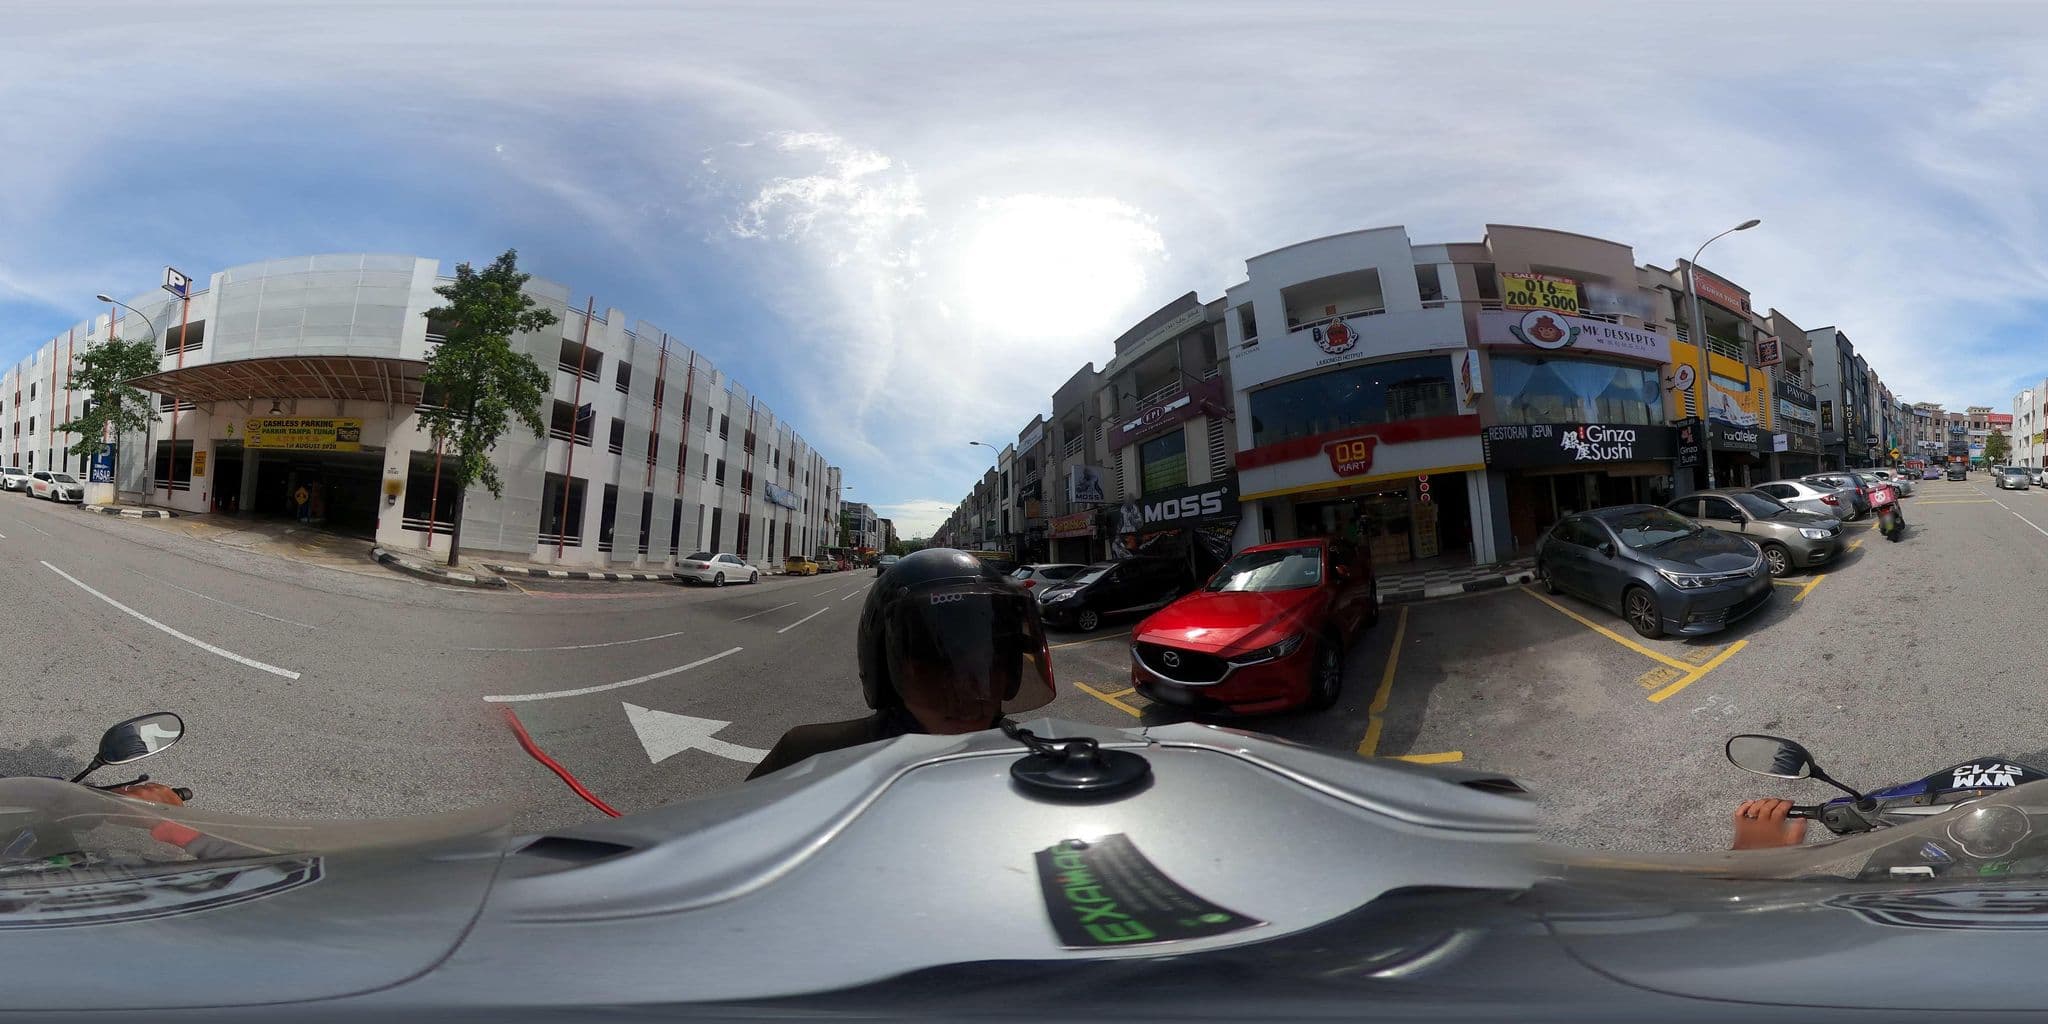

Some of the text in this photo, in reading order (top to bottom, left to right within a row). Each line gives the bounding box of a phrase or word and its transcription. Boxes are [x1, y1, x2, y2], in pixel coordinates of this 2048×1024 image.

[1525, 279, 1556, 295] 016
[1507, 290, 1538, 306] 206
[1543, 293, 1577, 312] 5000
[1604, 327, 1657, 347] DESSERTS
[1787, 384, 1809, 401] PAYOT
[263, 420, 334, 428] CASHLESS PARKING
[1846, 406, 1854, 435] HOTEL
[1489, 425, 1553, 441] RESTORAN JEPUN
[1586, 425, 1636, 442] Ginza
[1336, 441, 1366, 463] 0.9
[1591, 443, 1633, 461] Sushi
[1339, 461, 1366, 473] MART
[1144, 490, 1223, 523] MOSS
[1952, 763, 2023, 777] 5713
[1952, 773, 2016, 789] WYM
